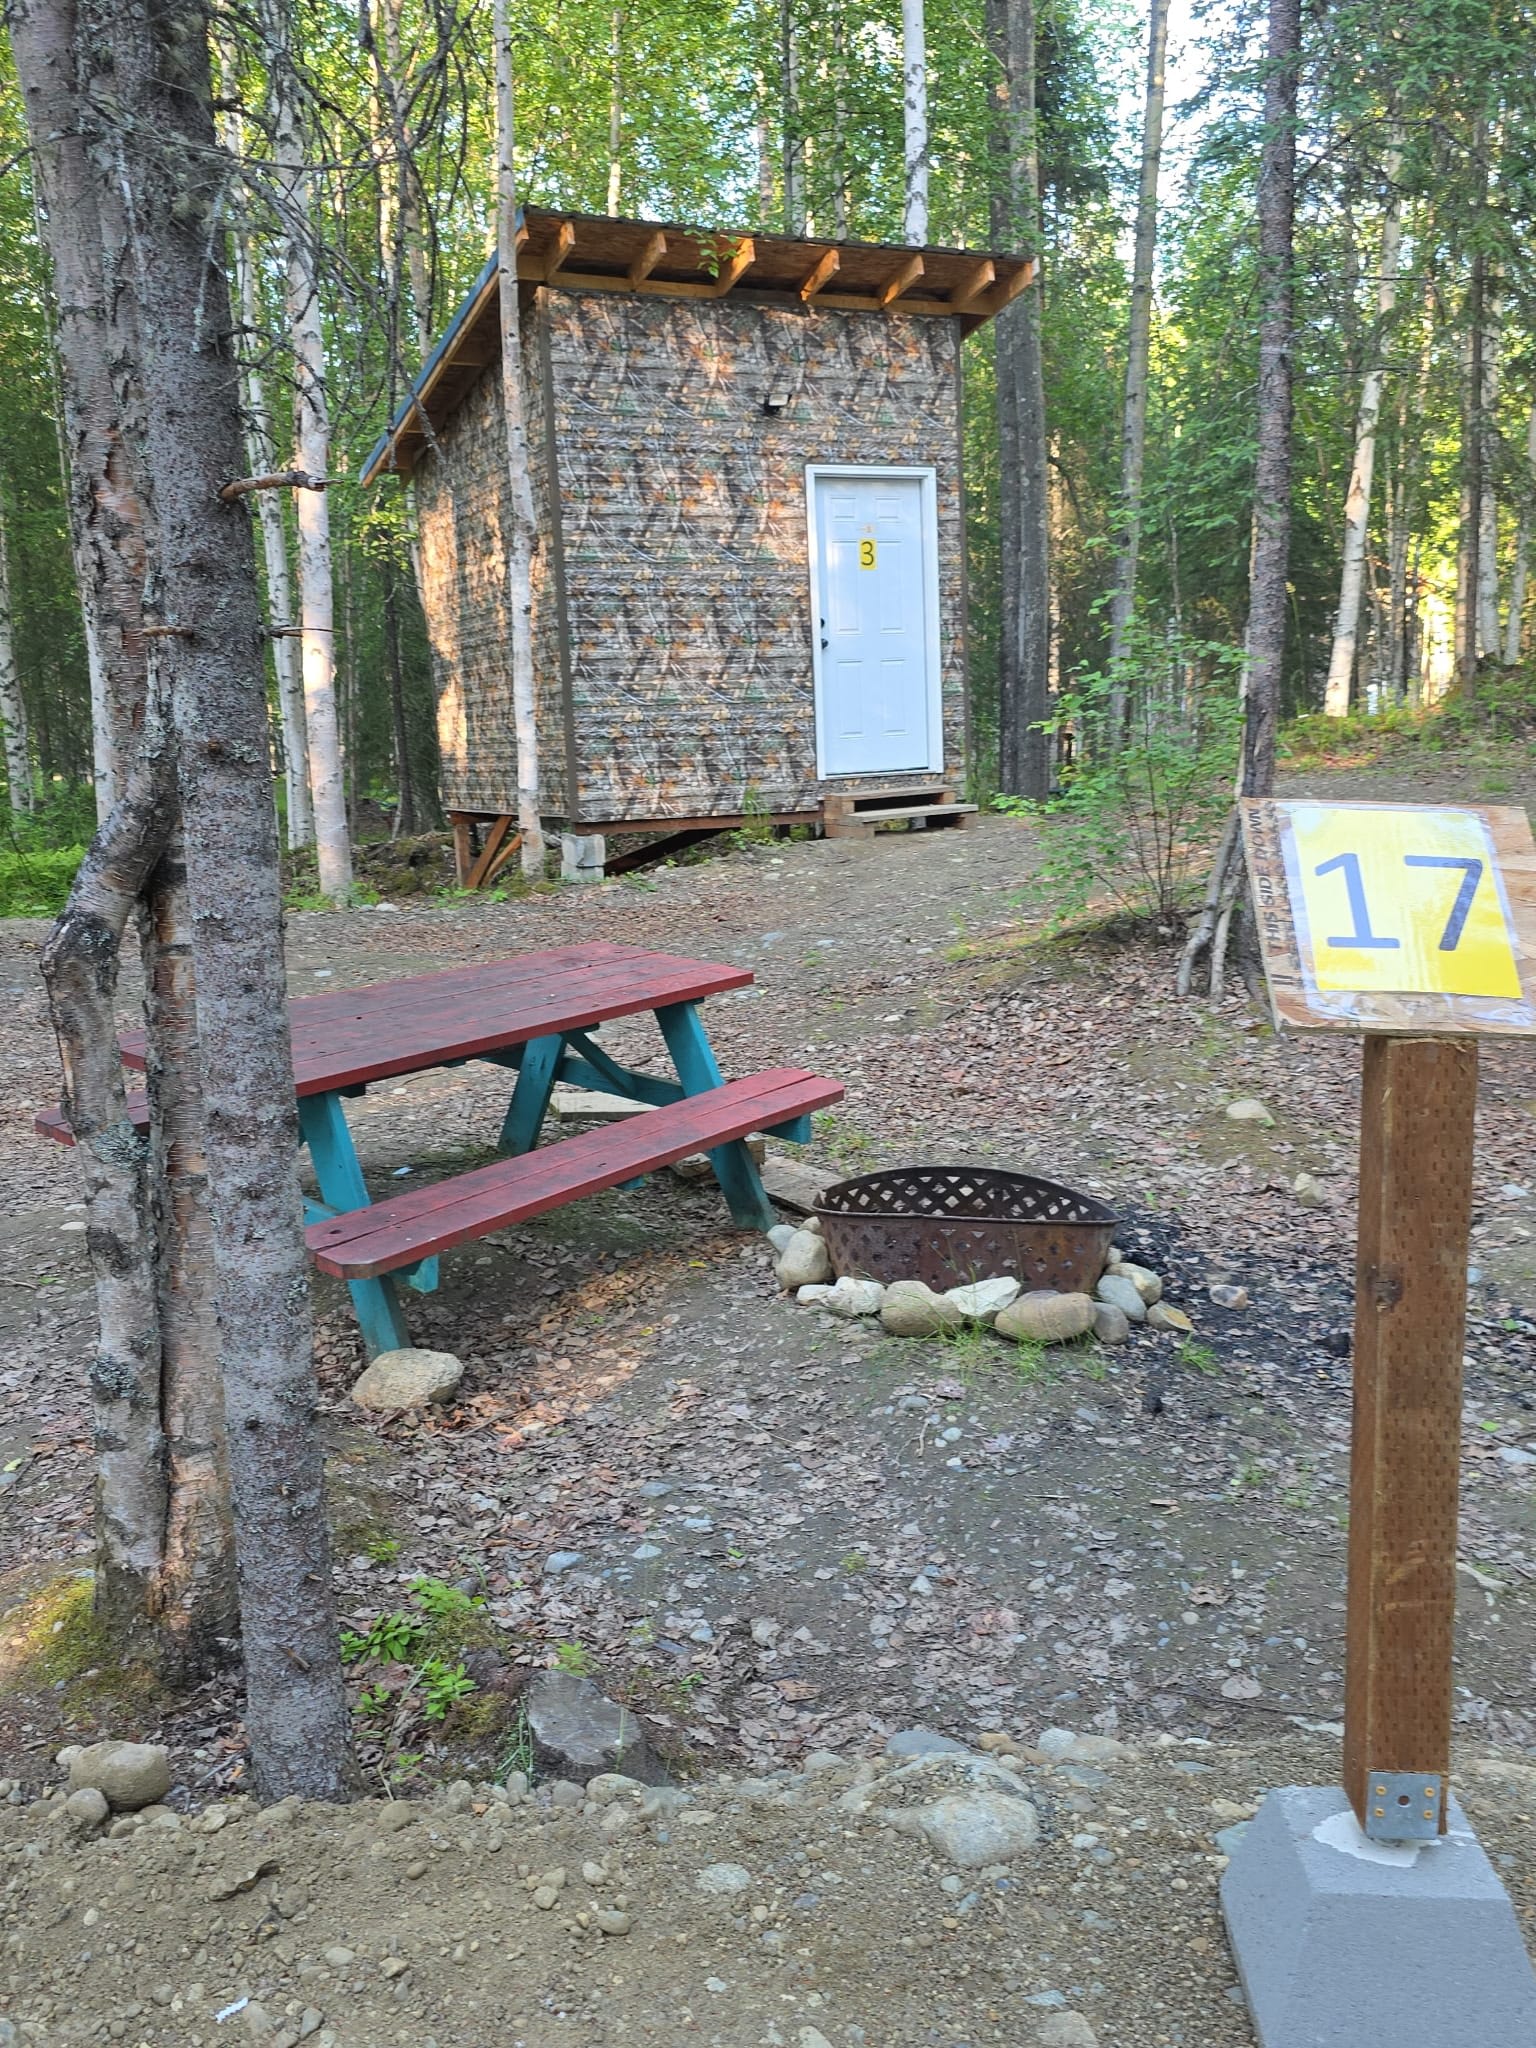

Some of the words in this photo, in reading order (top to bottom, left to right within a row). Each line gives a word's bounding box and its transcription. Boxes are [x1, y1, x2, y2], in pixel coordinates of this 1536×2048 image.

[861, 541, 874, 566] 3
[1248, 808, 1268, 859] DOWN
[1254, 865, 1275, 906] SIDE
[1315, 853, 1482, 951] 17
[1264, 912, 1282, 951] THIS
